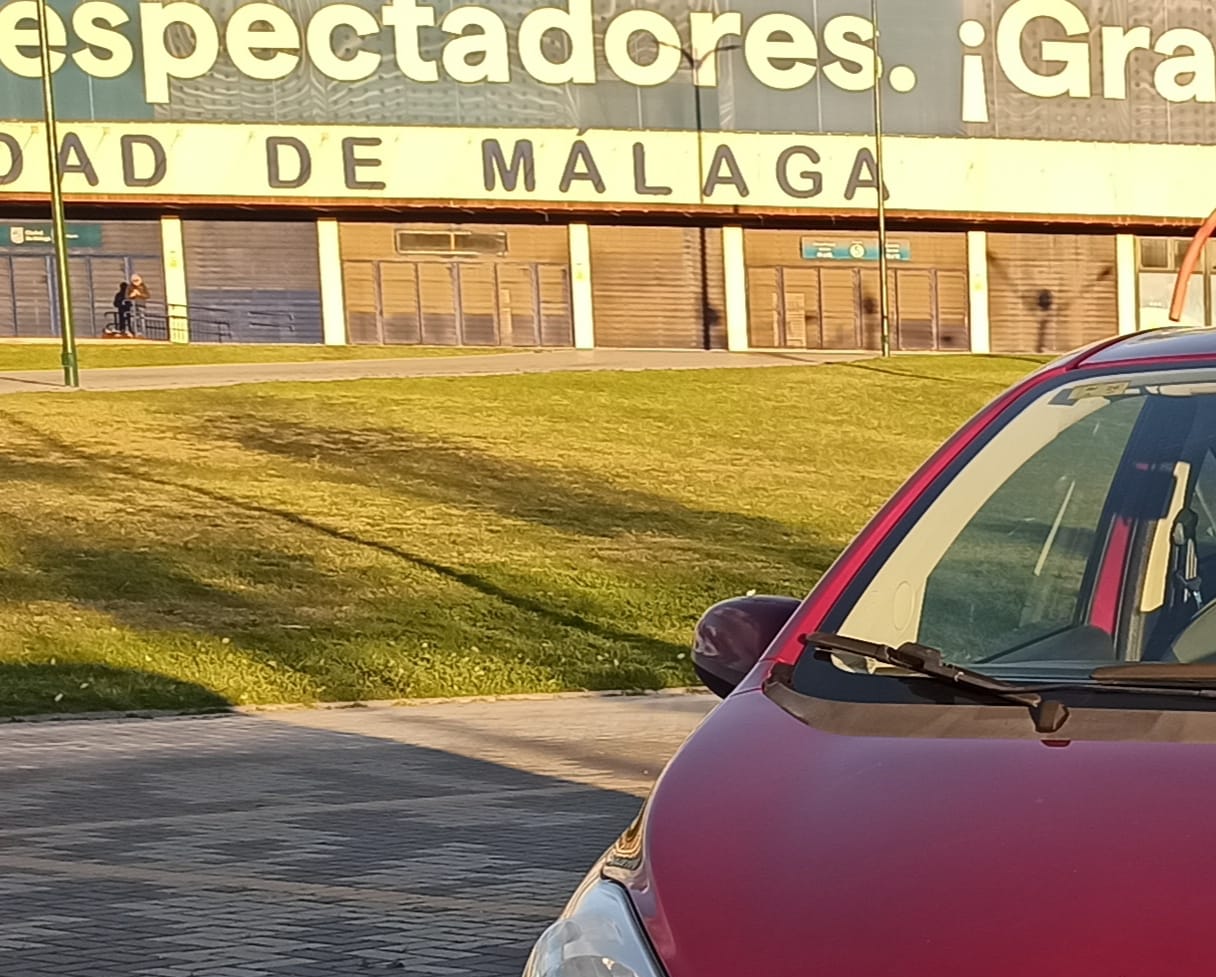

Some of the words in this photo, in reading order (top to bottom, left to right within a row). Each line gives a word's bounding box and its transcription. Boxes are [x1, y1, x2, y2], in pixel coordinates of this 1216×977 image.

[0, 0, 917, 103] espectadores.
[266, 136, 386, 190] DE
[481, 128, 889, 201] MÁLAGA
